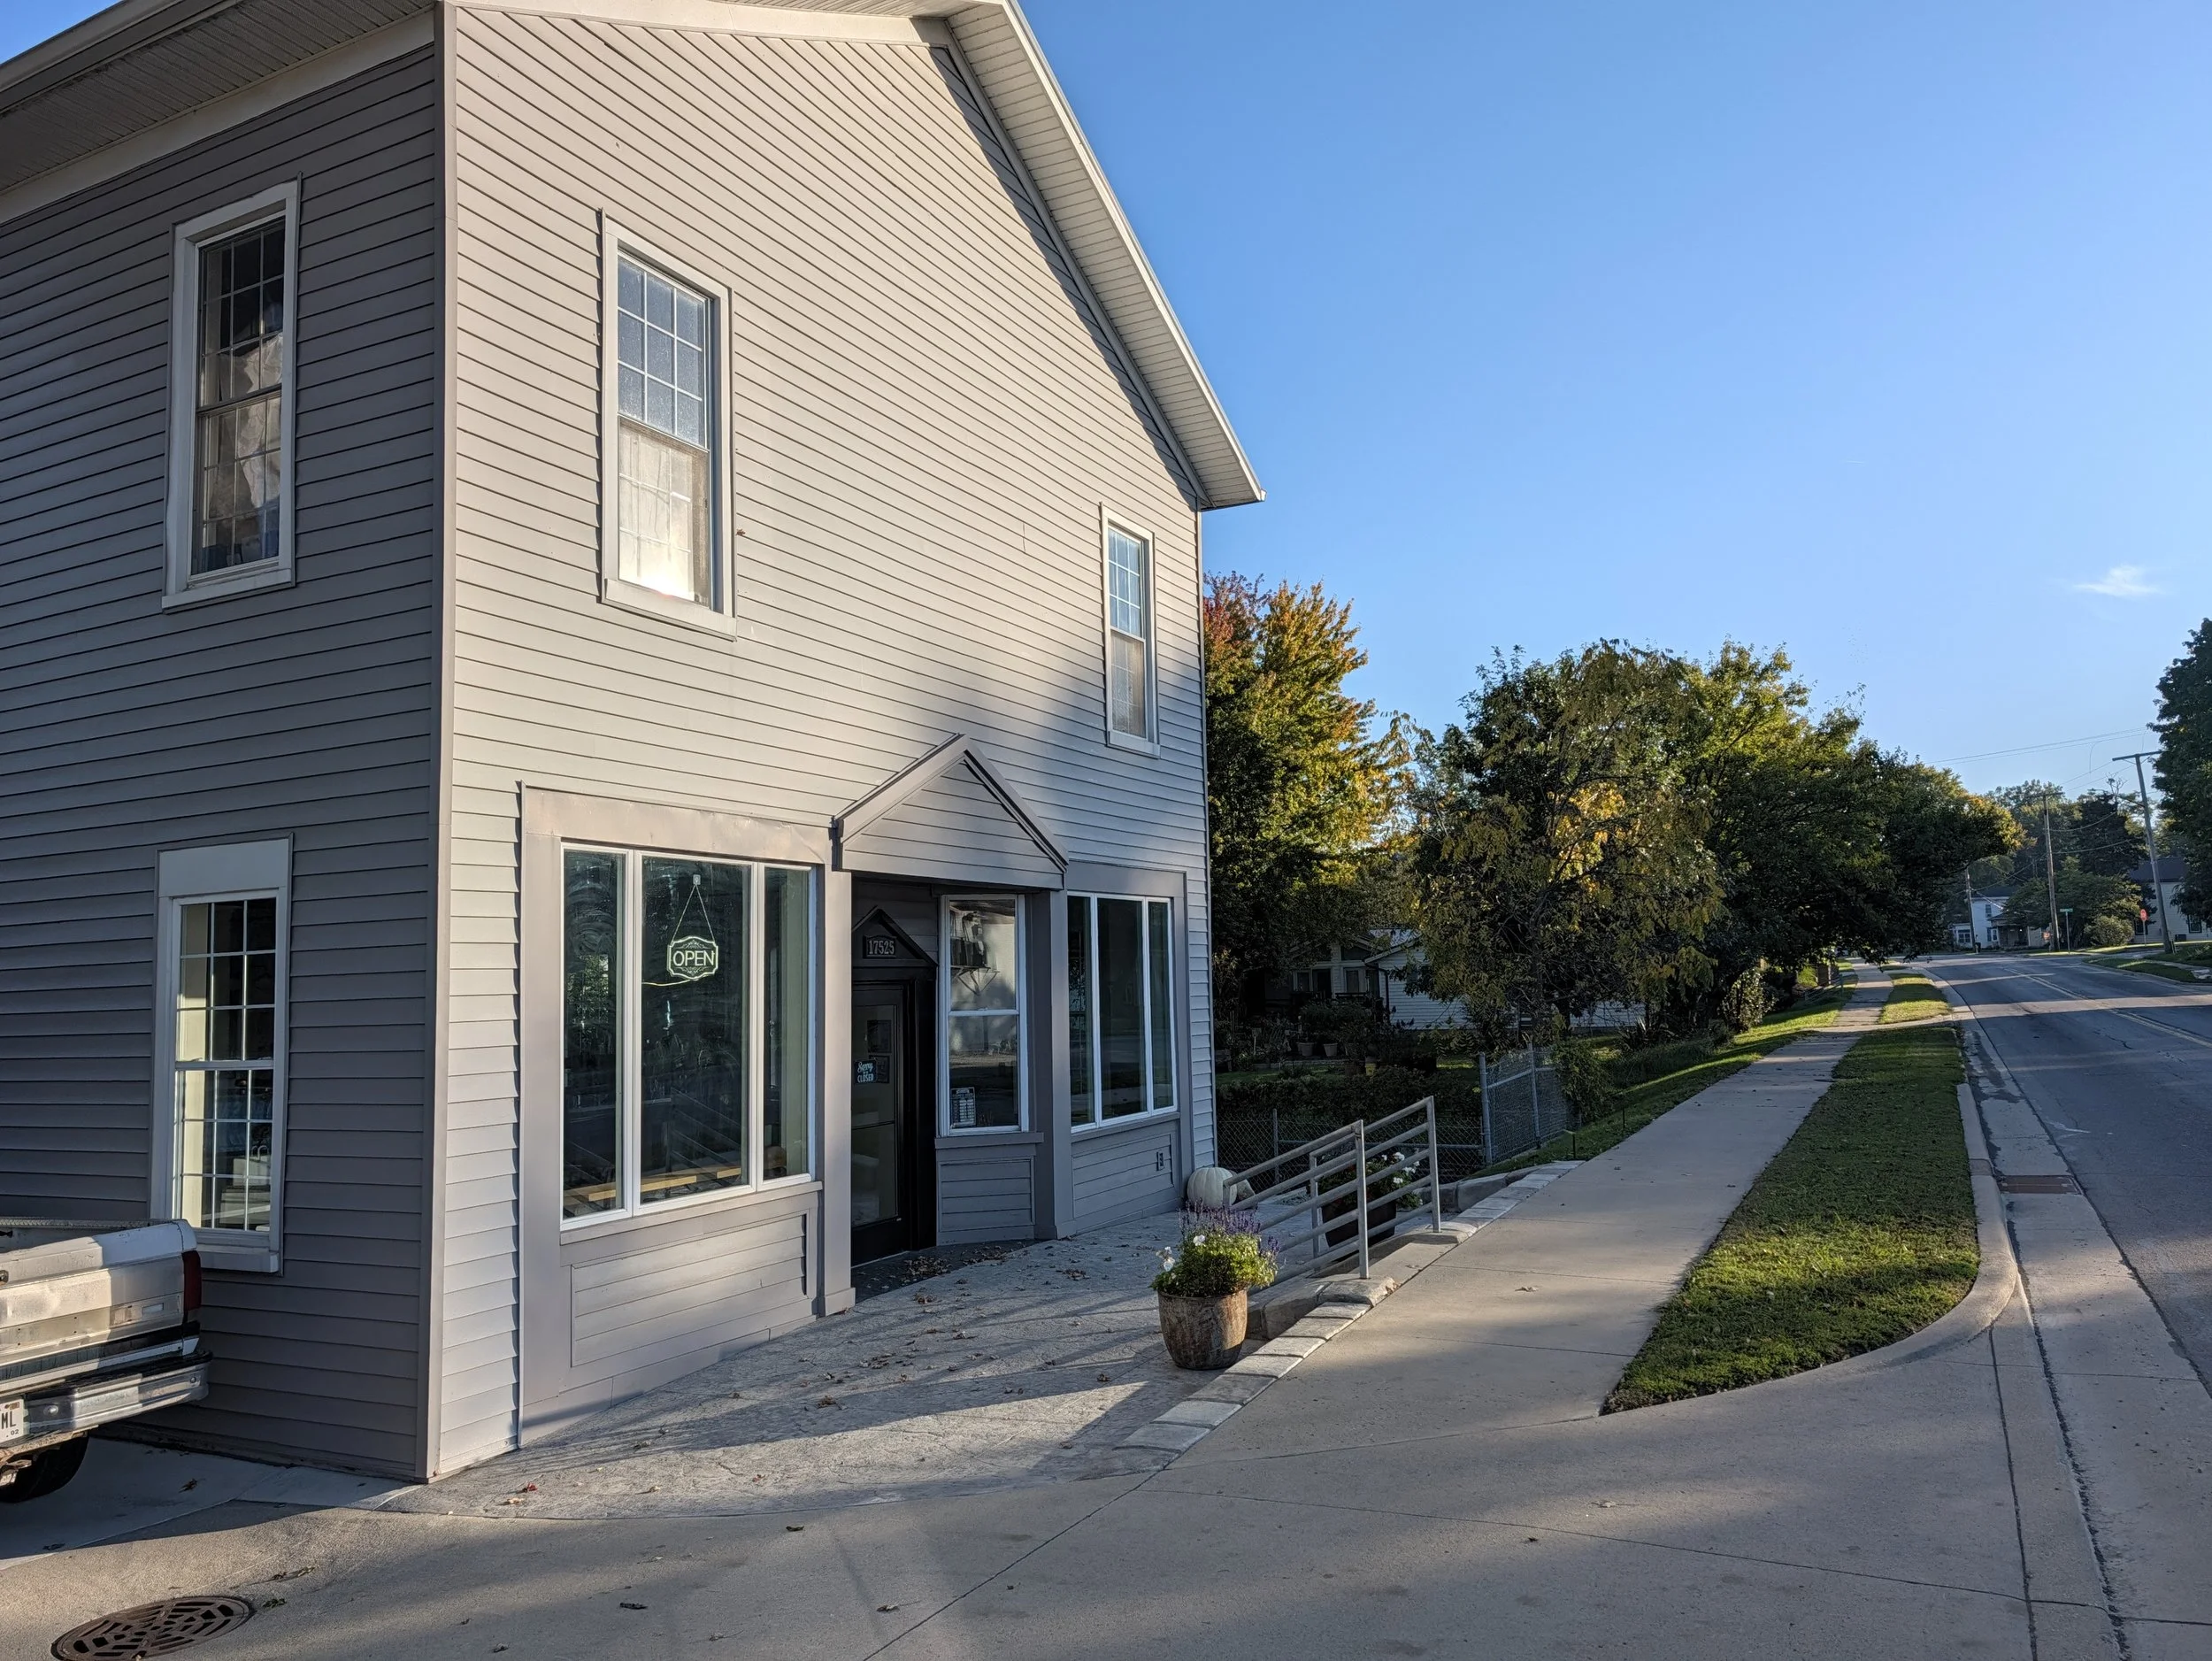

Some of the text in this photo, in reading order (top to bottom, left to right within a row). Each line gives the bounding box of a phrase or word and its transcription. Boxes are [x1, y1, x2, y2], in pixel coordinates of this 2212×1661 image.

[869, 940, 895, 955] 17525
[672, 950, 715, 966] OPEN
[857, 1062, 873, 1073] Sorry
[857, 1073, 874, 1082] CLOSED
[1, 1411, 16, 1429] ML
